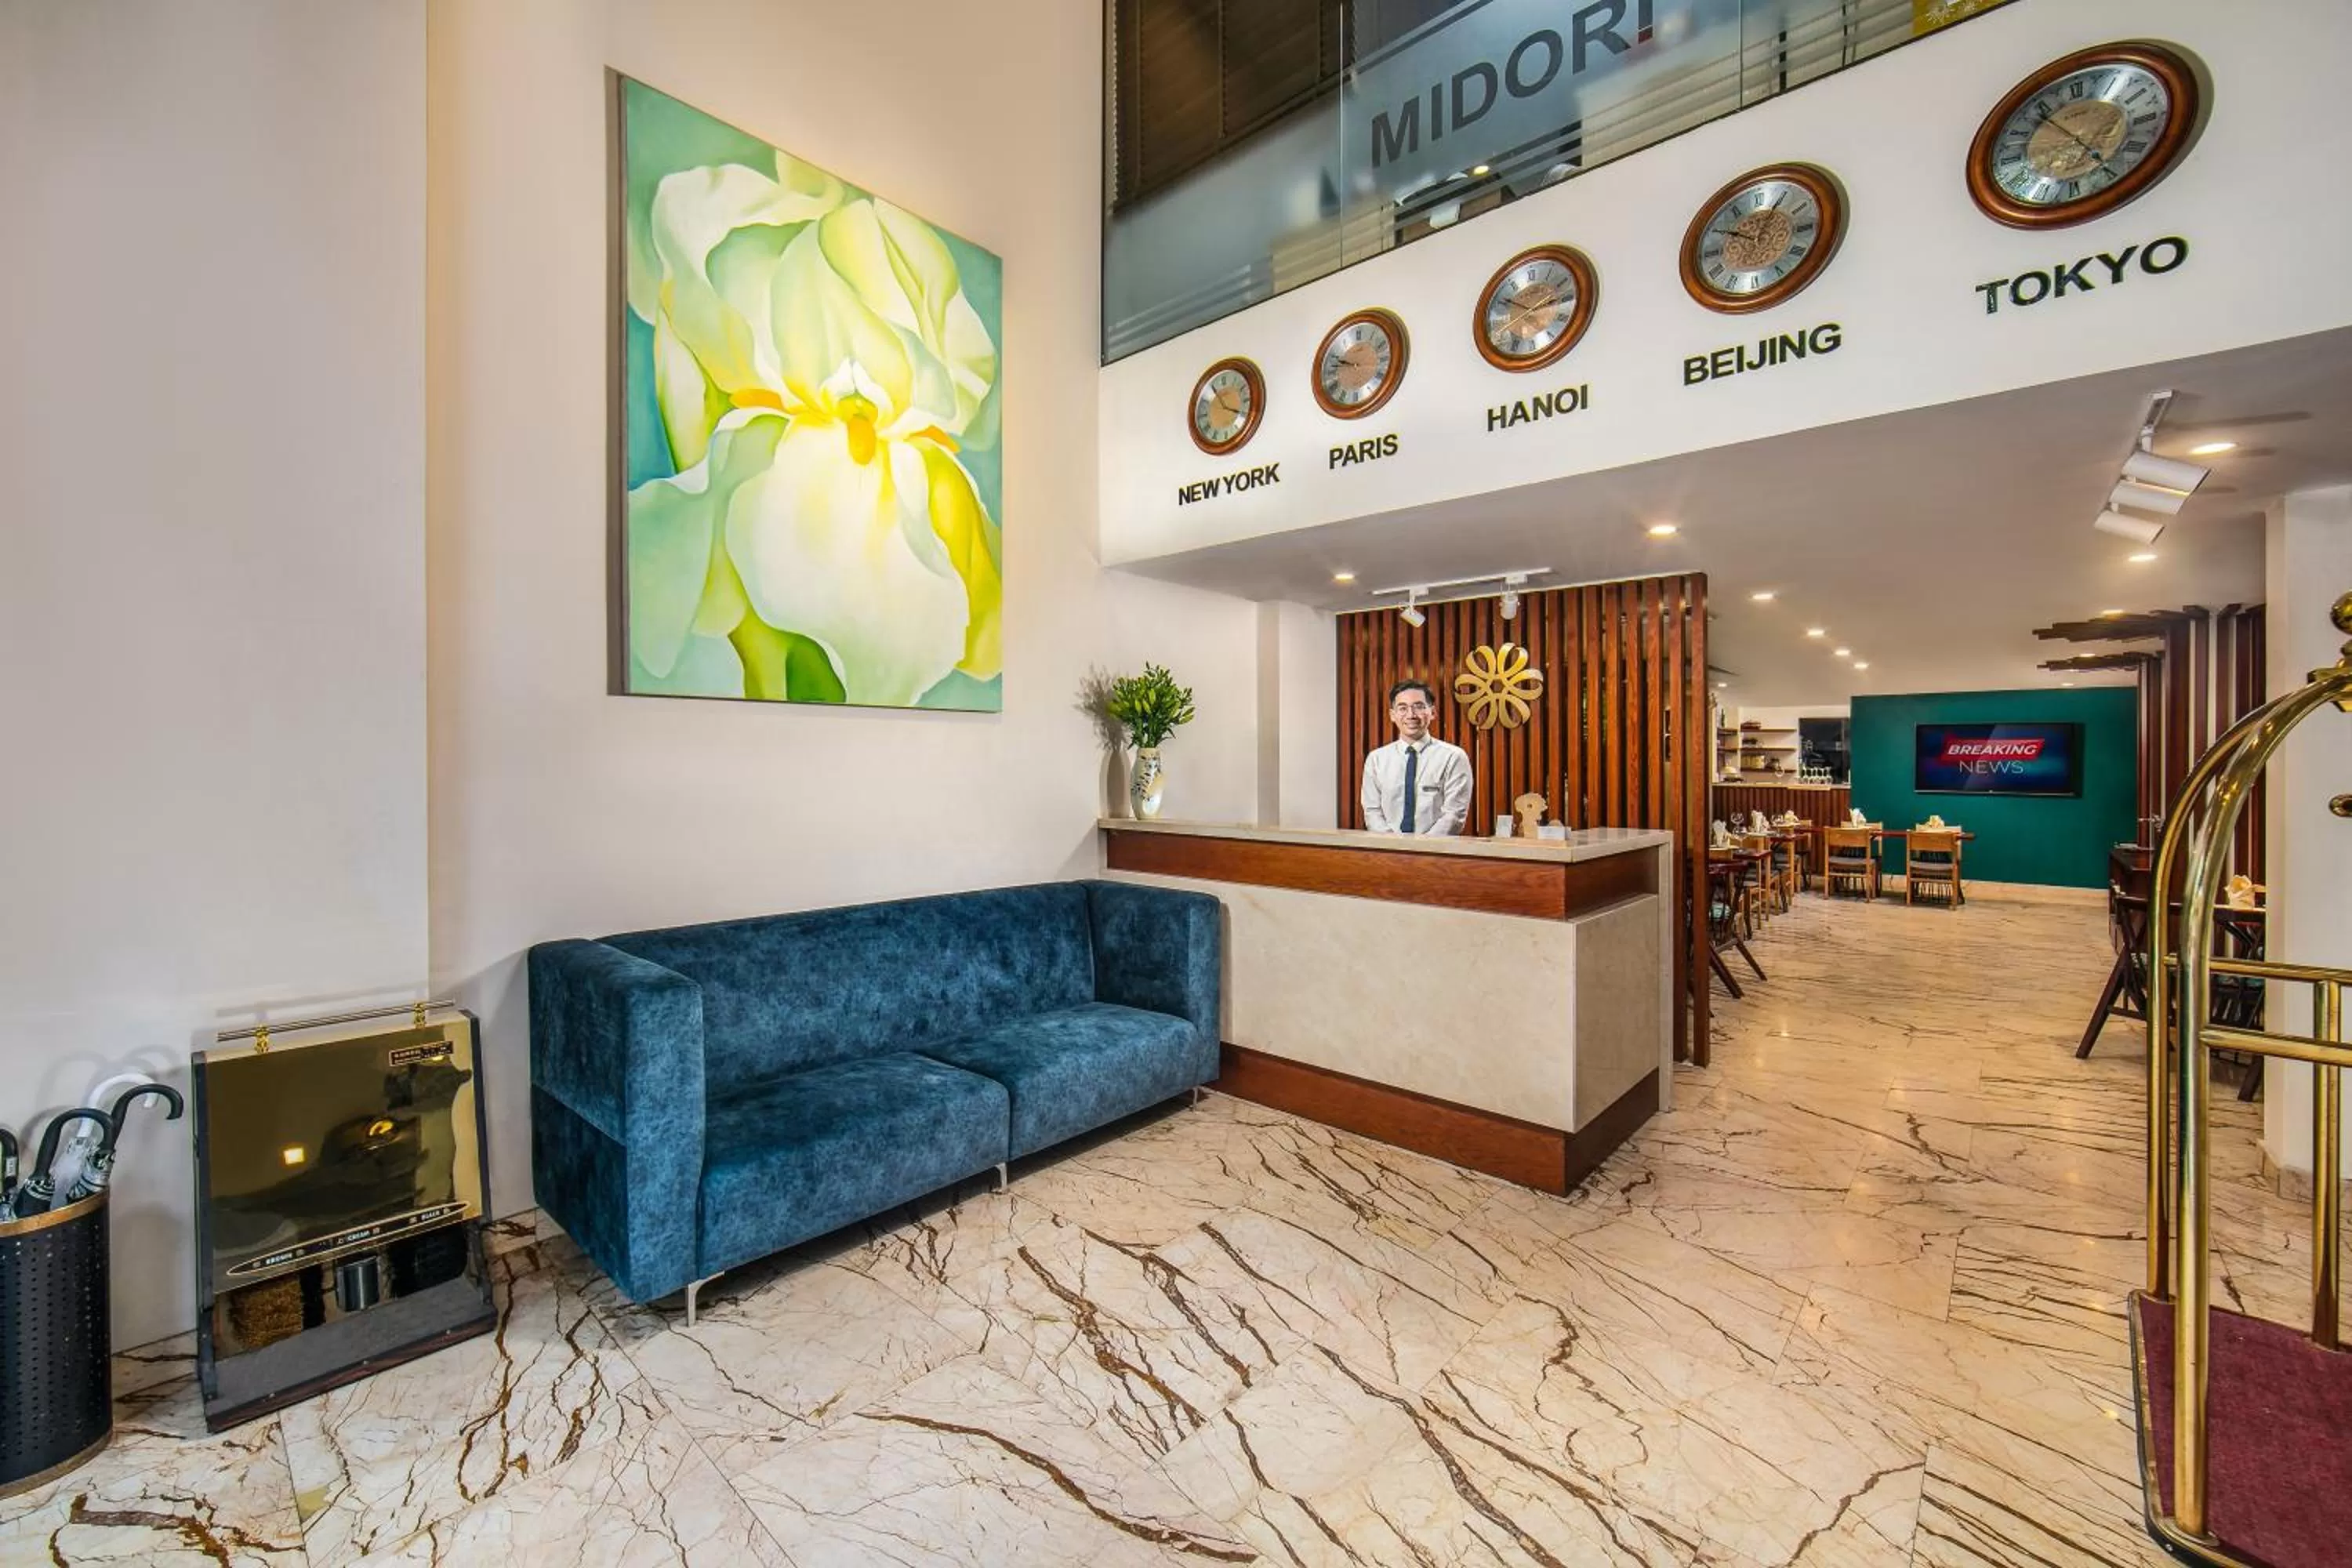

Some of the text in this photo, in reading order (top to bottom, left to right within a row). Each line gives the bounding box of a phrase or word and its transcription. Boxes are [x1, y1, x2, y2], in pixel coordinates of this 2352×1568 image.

[1372, 0, 1653, 169] MIDORI
[1975, 236, 2190, 314] TOKYO
[1683, 322, 1842, 386] BEIJING
[1487, 384, 1588, 431] HANOI
[1329, 434, 1399, 470] PARIS
[1178, 463, 1279, 506] NEW YORK
[1947, 744, 2038, 755] BREAKING
[1959, 760, 2024, 774] NEWS
